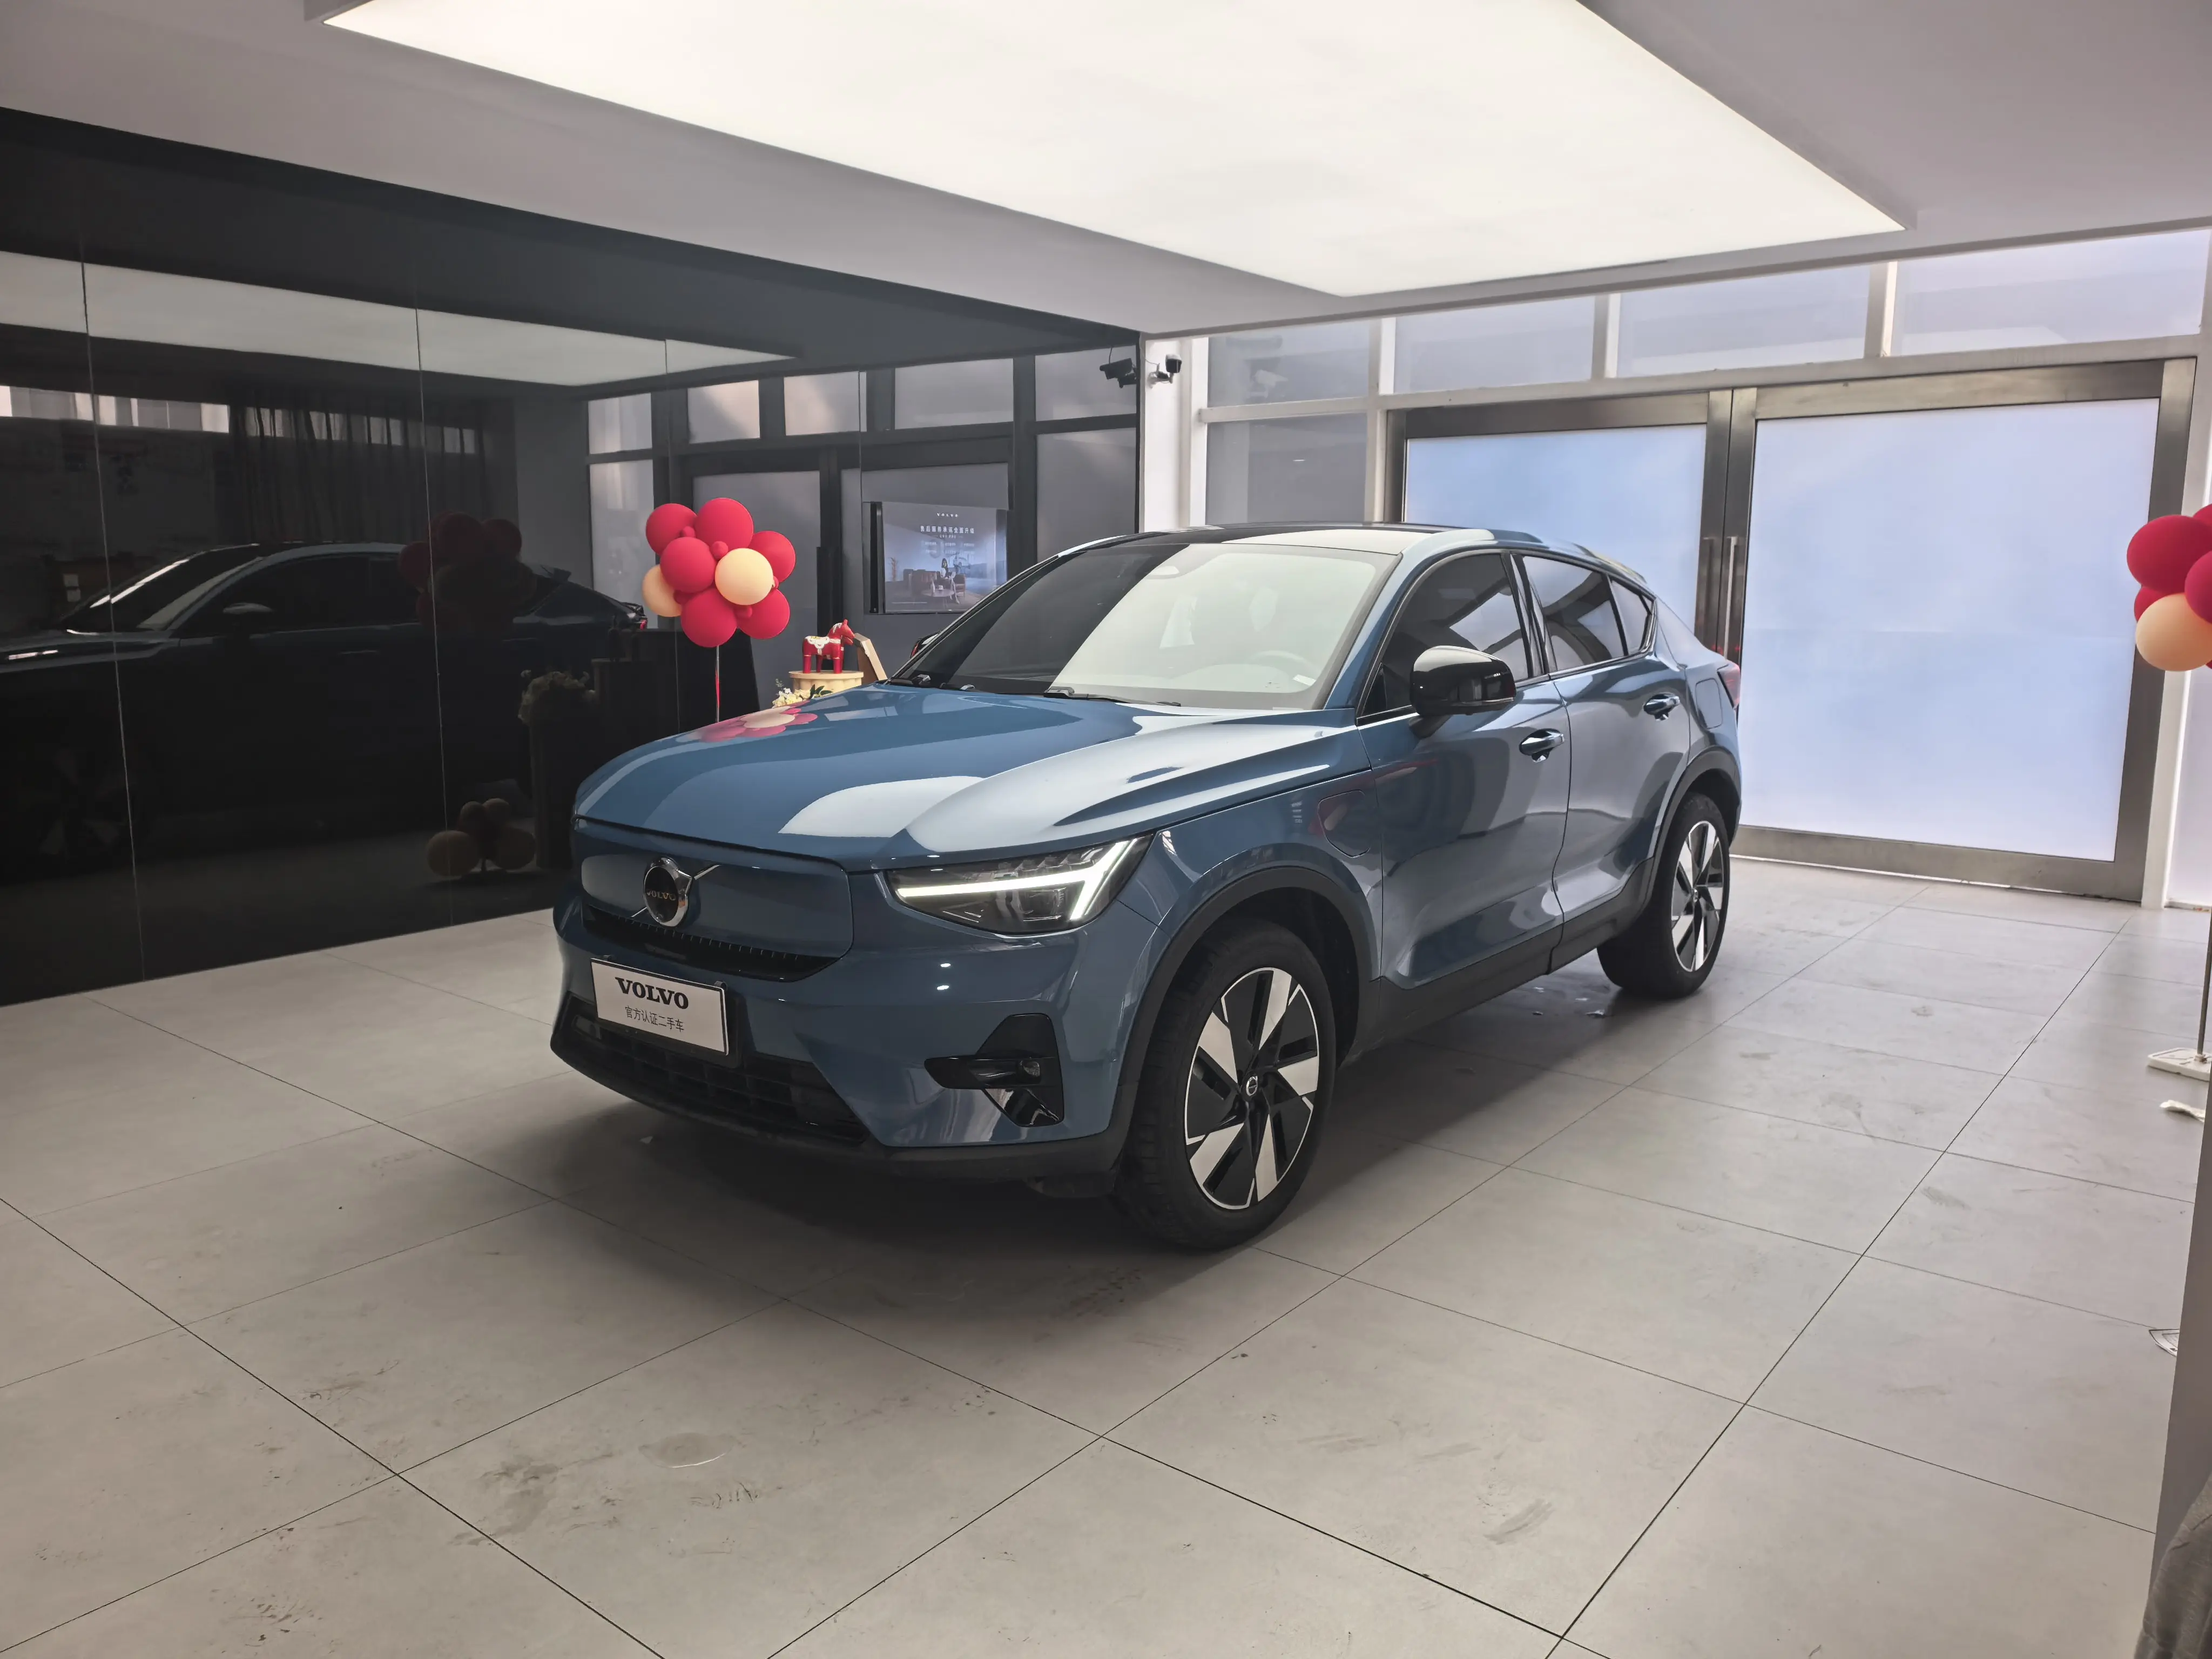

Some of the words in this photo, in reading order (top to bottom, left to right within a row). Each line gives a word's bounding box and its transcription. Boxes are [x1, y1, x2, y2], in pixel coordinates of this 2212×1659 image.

[647, 890, 676, 901] VOLVO
[615, 977, 689, 1009] VOLVO
[625, 1006, 684, 1033] 官方认证二手车
